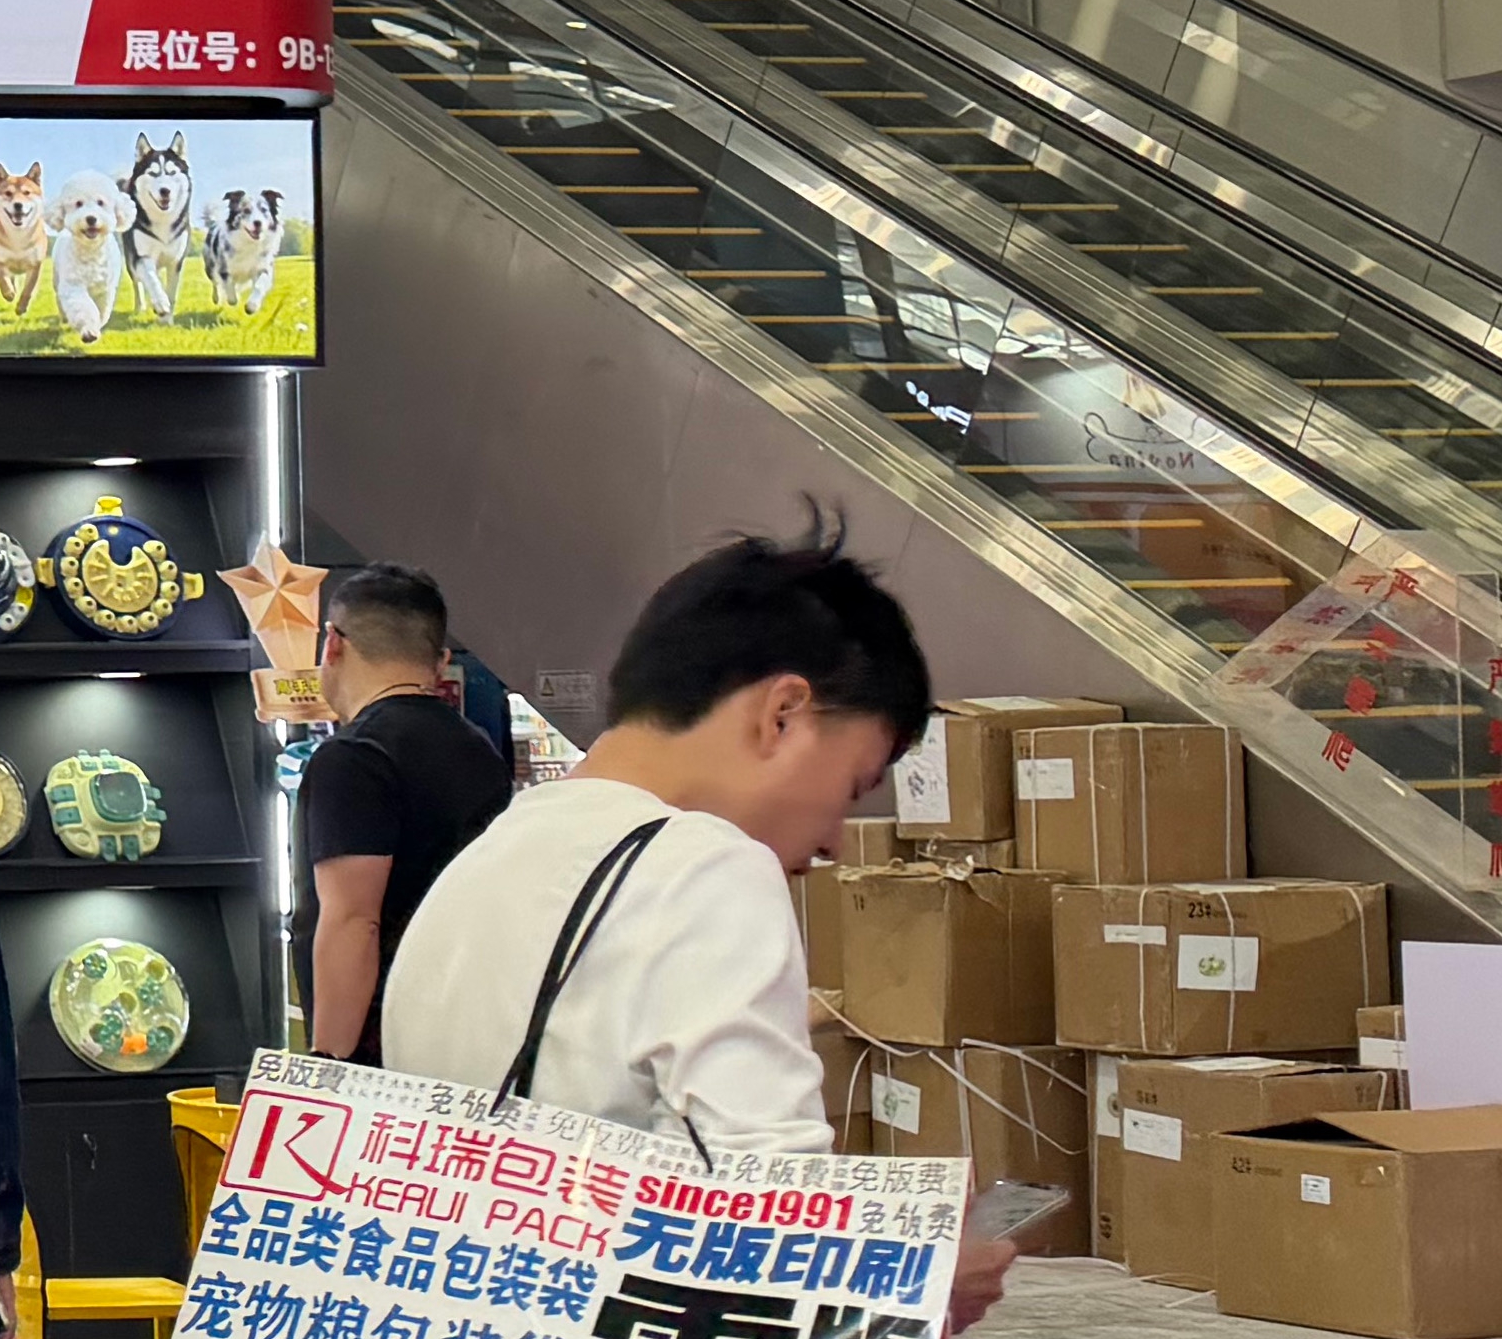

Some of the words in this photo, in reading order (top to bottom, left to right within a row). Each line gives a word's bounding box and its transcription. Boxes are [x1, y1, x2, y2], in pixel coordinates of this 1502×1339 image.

[360, 1112, 631, 1218] 科瑞包装
[635, 1175, 855, 1231] since1991
[201, 1192, 597, 1322] 全品类食品包装袋
[345, 1172, 469, 1223] KERUI
[484, 1199, 615, 1258] PACK
[613, 1207, 935, 1304] 无版印刷
